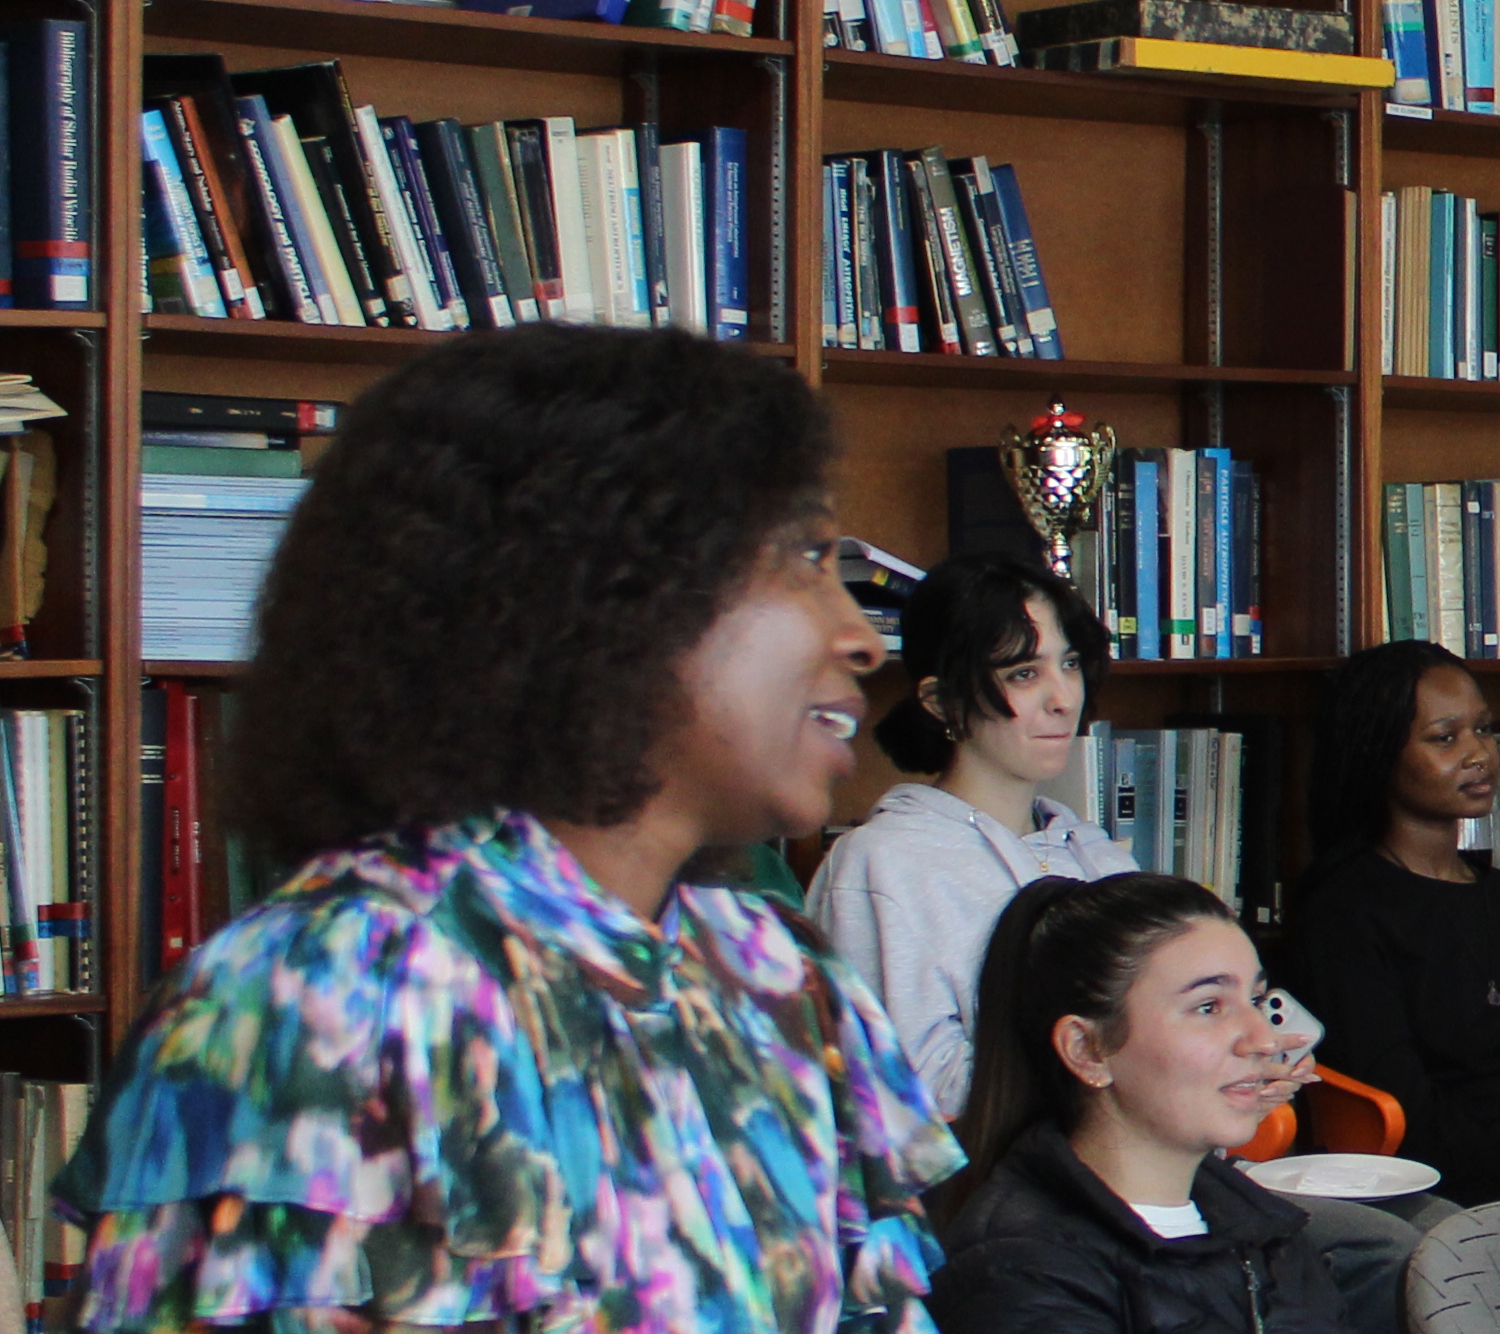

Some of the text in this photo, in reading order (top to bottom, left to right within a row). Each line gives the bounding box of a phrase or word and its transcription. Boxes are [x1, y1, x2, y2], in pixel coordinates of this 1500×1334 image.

[57, 32, 76, 104] Bibliography
[59, 120, 77, 158] Stellar
[60, 106, 77, 120] of
[60, 160, 78, 197] Radial
[183, 132, 196, 156] Stars
[190, 157, 203, 175] and
[248, 139, 284, 219] COSMOLOGY
[276, 220, 292, 245] and
[840, 189, 855, 323] HIGH ENERGY ASTROPHYSIC
[940, 207, 974, 296] MAGNETISM
[1221, 469, 1229, 524] PARTICLE
